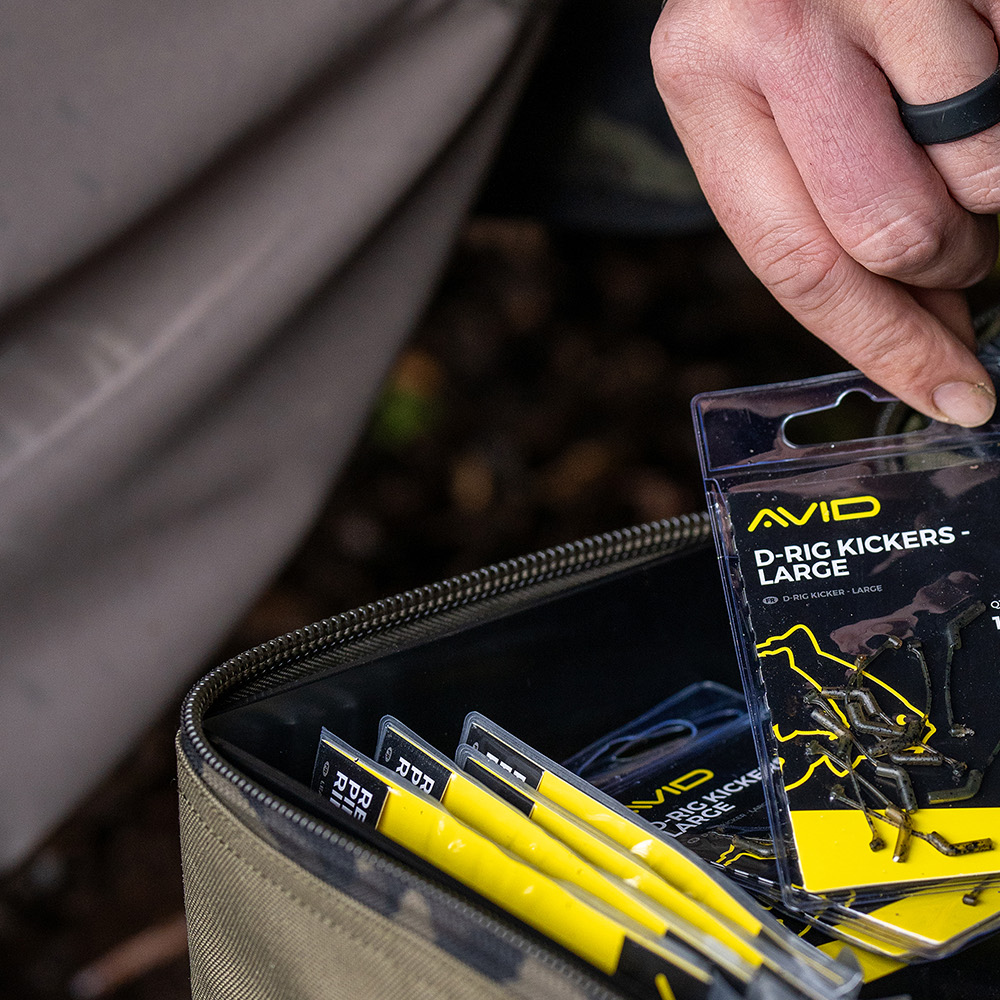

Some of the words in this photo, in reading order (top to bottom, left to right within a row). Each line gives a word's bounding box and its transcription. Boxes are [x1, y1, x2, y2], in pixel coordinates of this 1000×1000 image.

[748, 495, 881, 532] AVID
[754, 541, 832, 567] D-RIG
[837, 526, 956, 557] KICKERS
[758, 558, 850, 585] LARGE
[782, 593, 809, 602] D-RIG
[810, 588, 845, 599] KICKER
[851, 584, 883, 594] LARGE
[662, 801, 736, 837] LARGE
